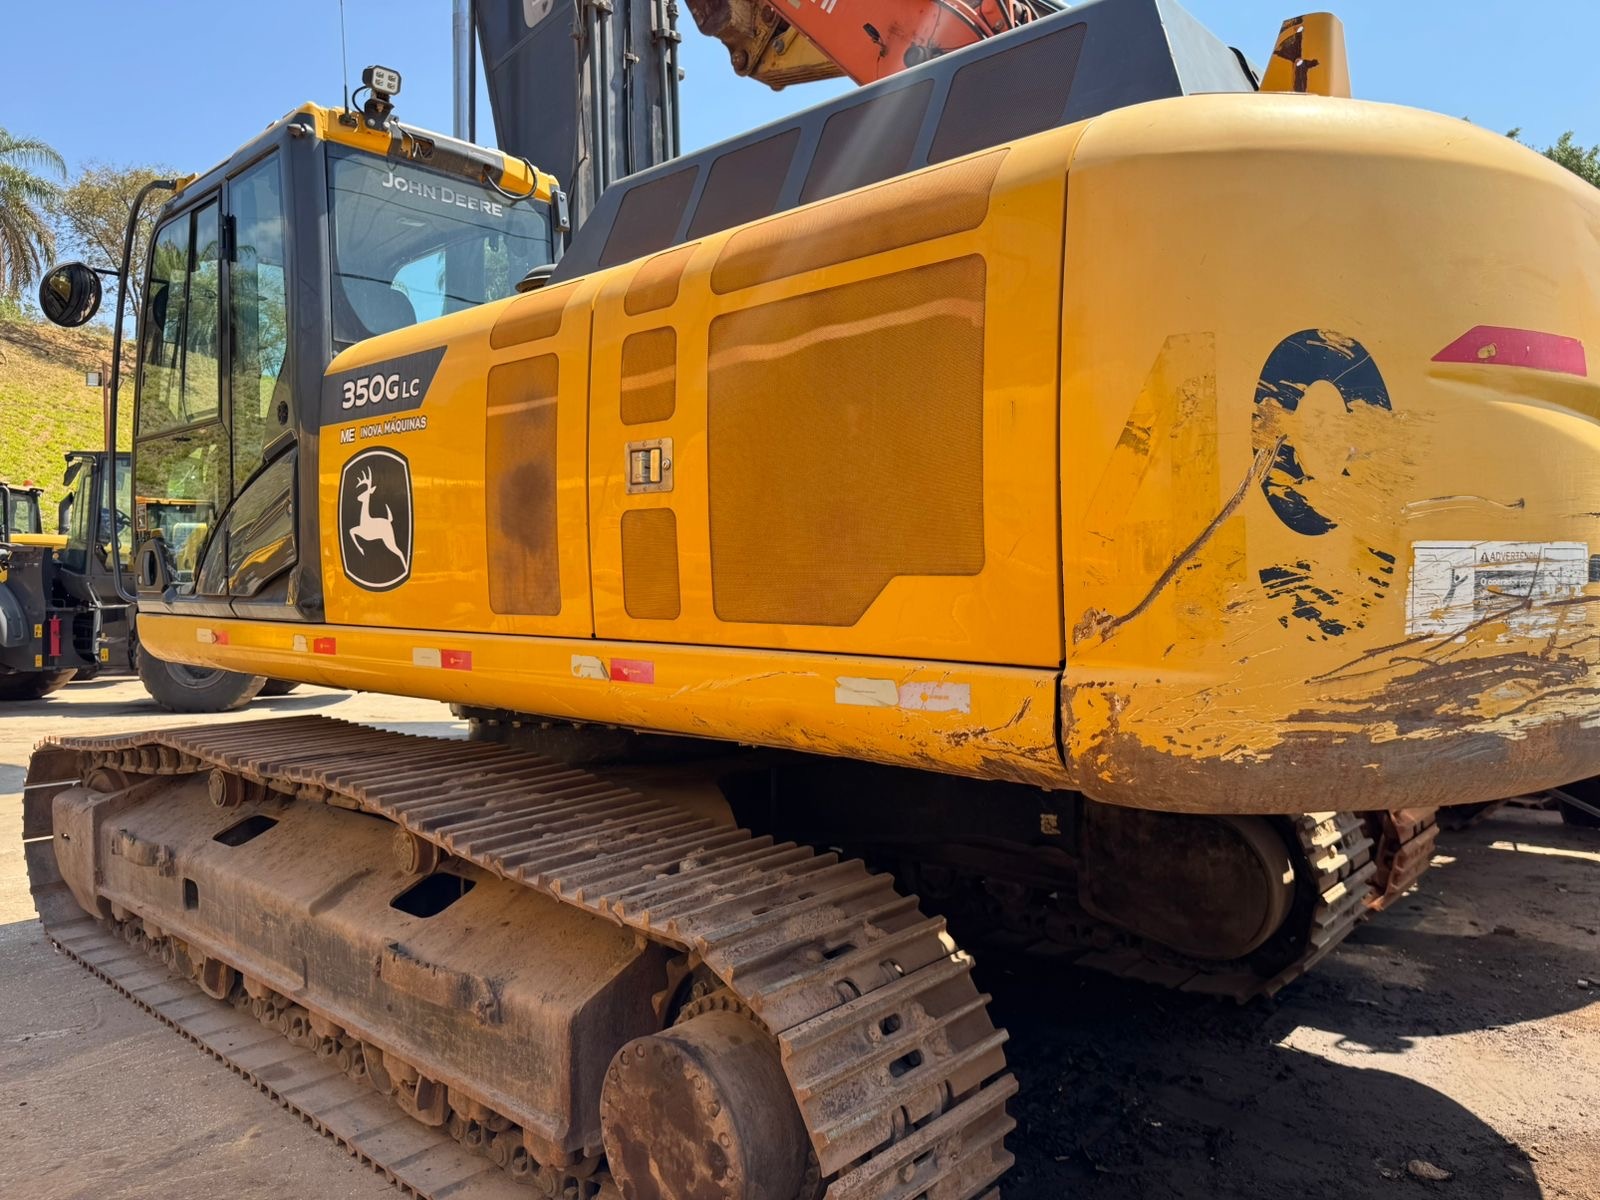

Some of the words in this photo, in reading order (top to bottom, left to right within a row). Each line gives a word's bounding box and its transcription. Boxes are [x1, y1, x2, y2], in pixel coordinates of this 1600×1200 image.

[382, 171, 437, 200] JOHN
[441, 187, 503, 217] DEERE
[342, 374, 400, 409] 350G
[402, 378, 420, 399] LC
[340, 427, 356, 444] ME
[360, 422, 383, 438] INOVA
[384, 414, 428, 434] MÁQUINAS
